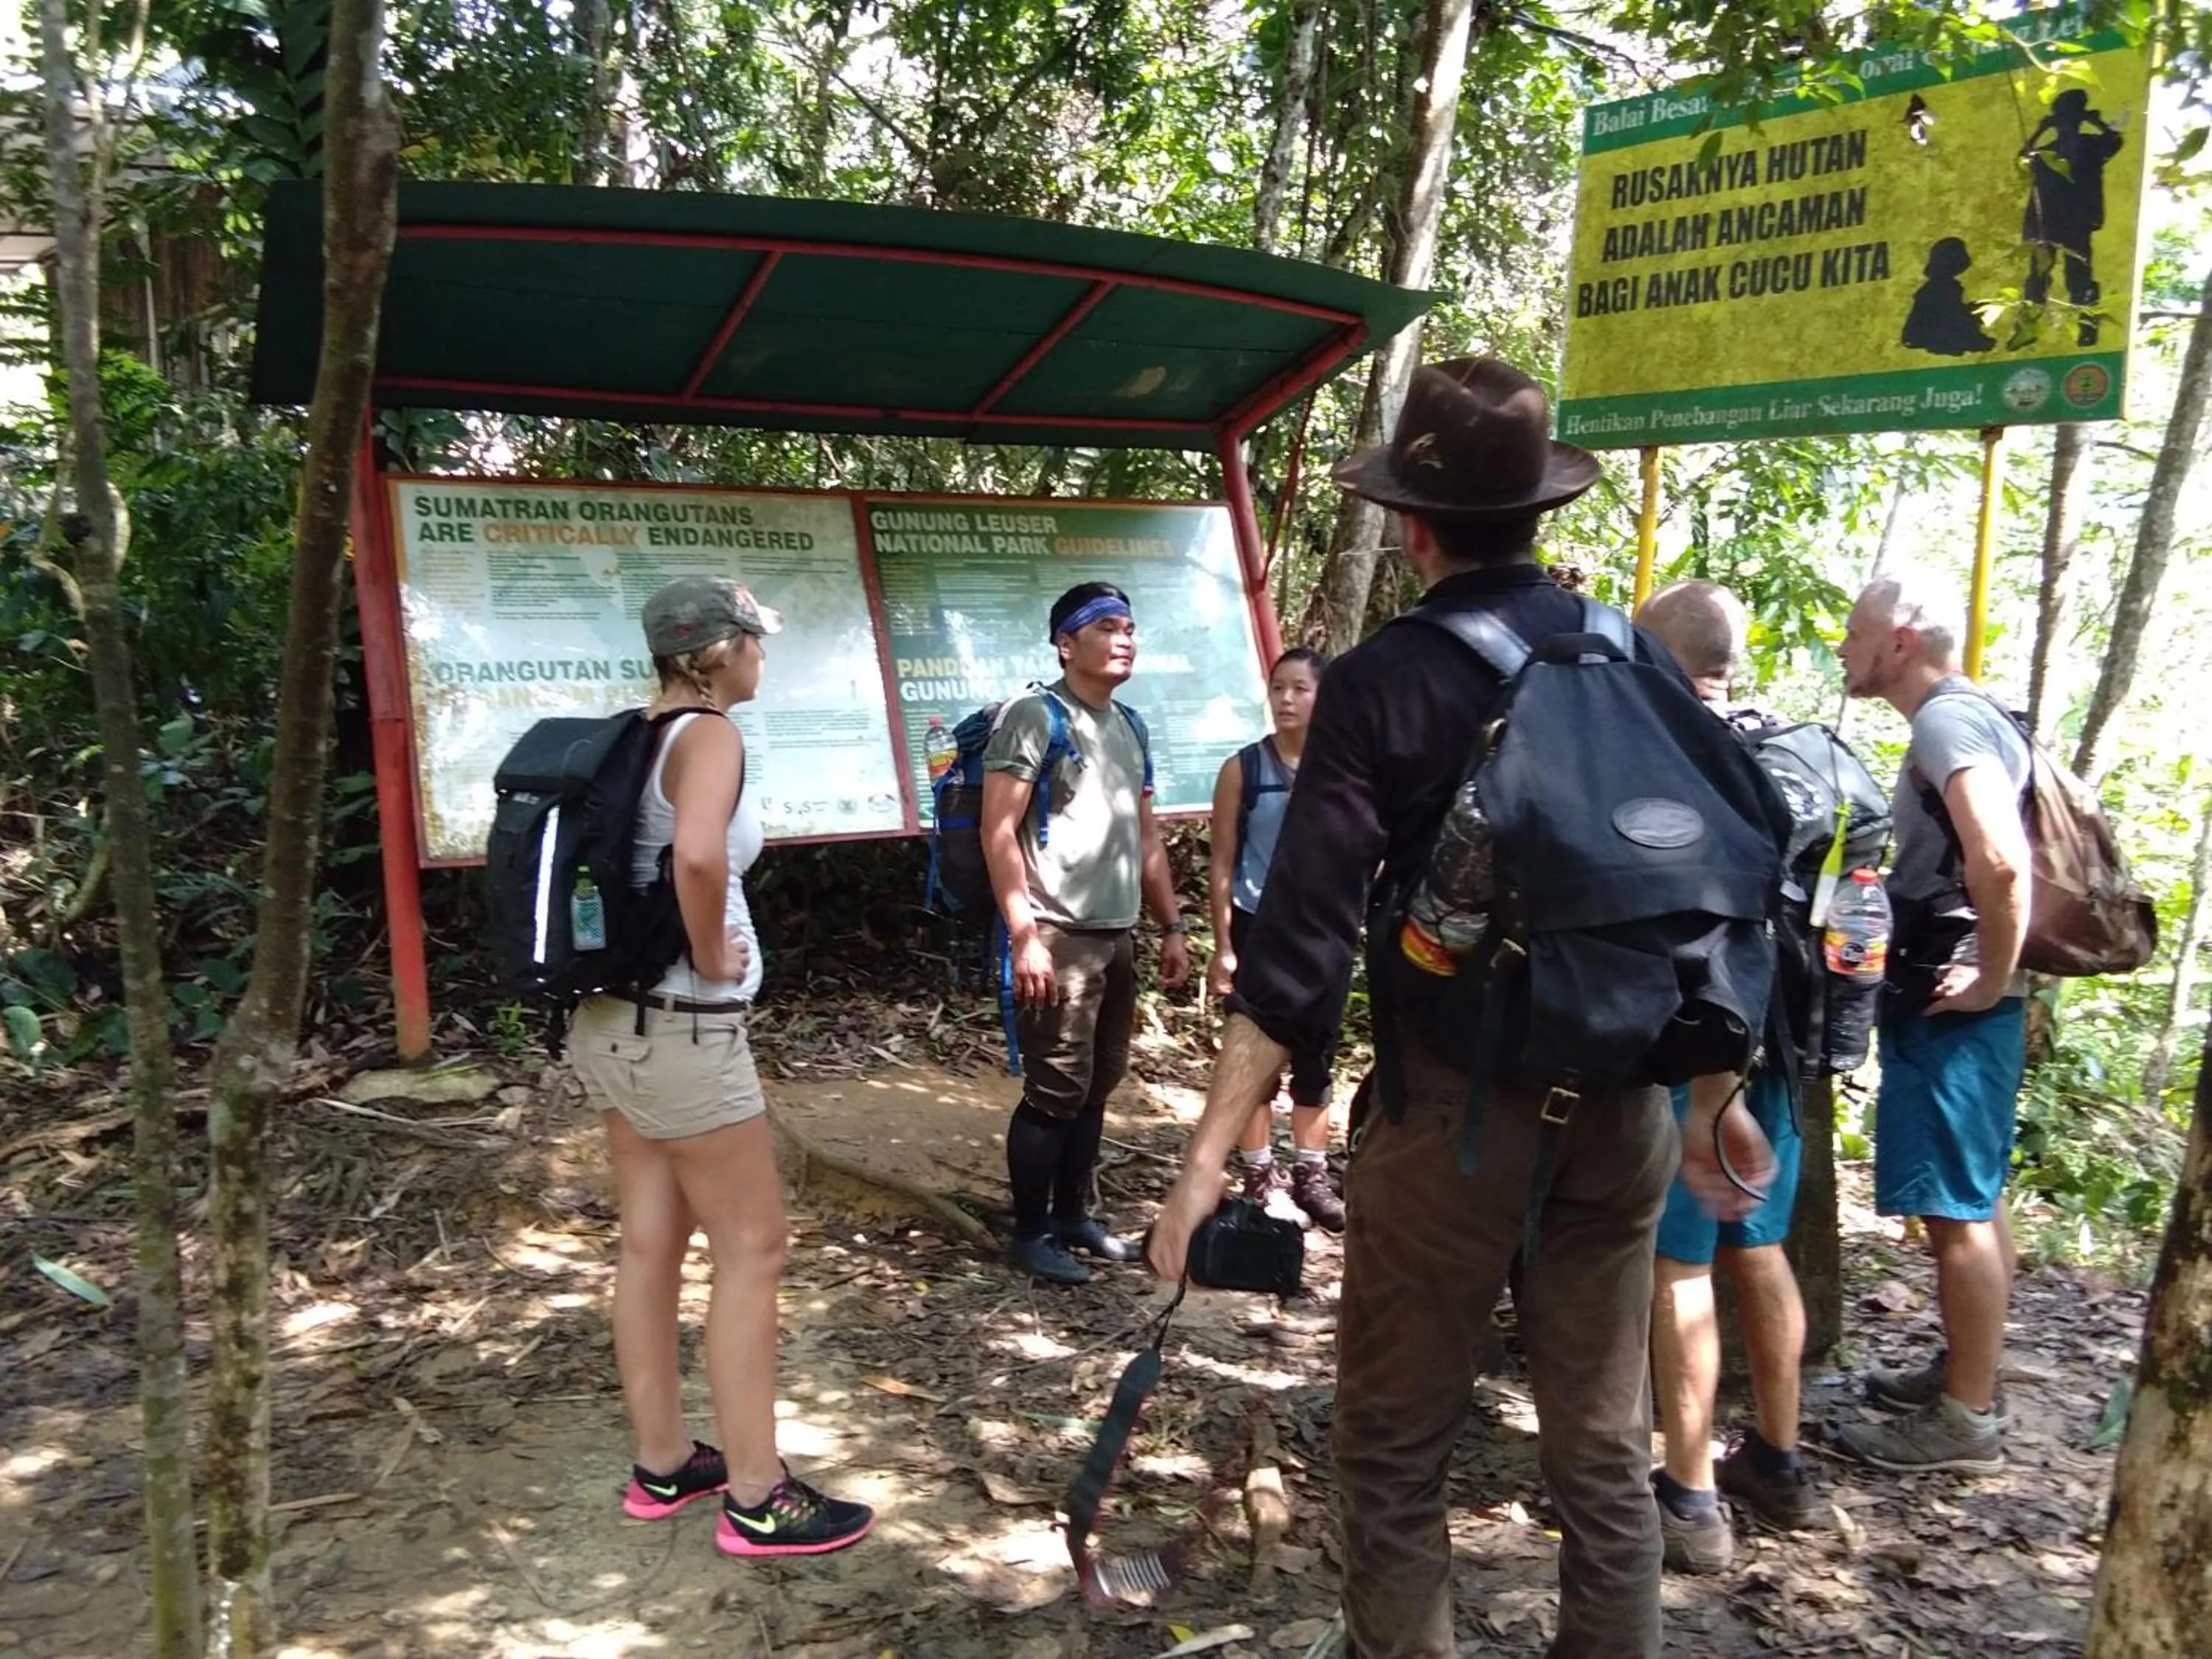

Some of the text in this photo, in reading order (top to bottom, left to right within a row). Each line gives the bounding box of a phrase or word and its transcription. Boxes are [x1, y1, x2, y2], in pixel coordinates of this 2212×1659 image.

[1593, 102, 1645, 136] Balai
[1611, 129, 1867, 210] RUSAKNYA HUTAN
[1601, 187, 1866, 263] ADALAH ANCAMAN
[1577, 241, 1889, 318] BAGI ANAK CUCU KITA
[1565, 383, 1983, 435] Hentikan Penebangan Liar Sekarang Juga!
[414, 495, 754, 526] SUMATRAN ORANGUTANS
[870, 511, 1058, 535] GUNUNG LEUSER
[418, 522, 815, 552] ARE CRITICALLY ENDANGERED
[874, 534, 1175, 558] NATIONAL PARK GUIDELINES
[434, 660, 611, 684] ORANGUTAN
